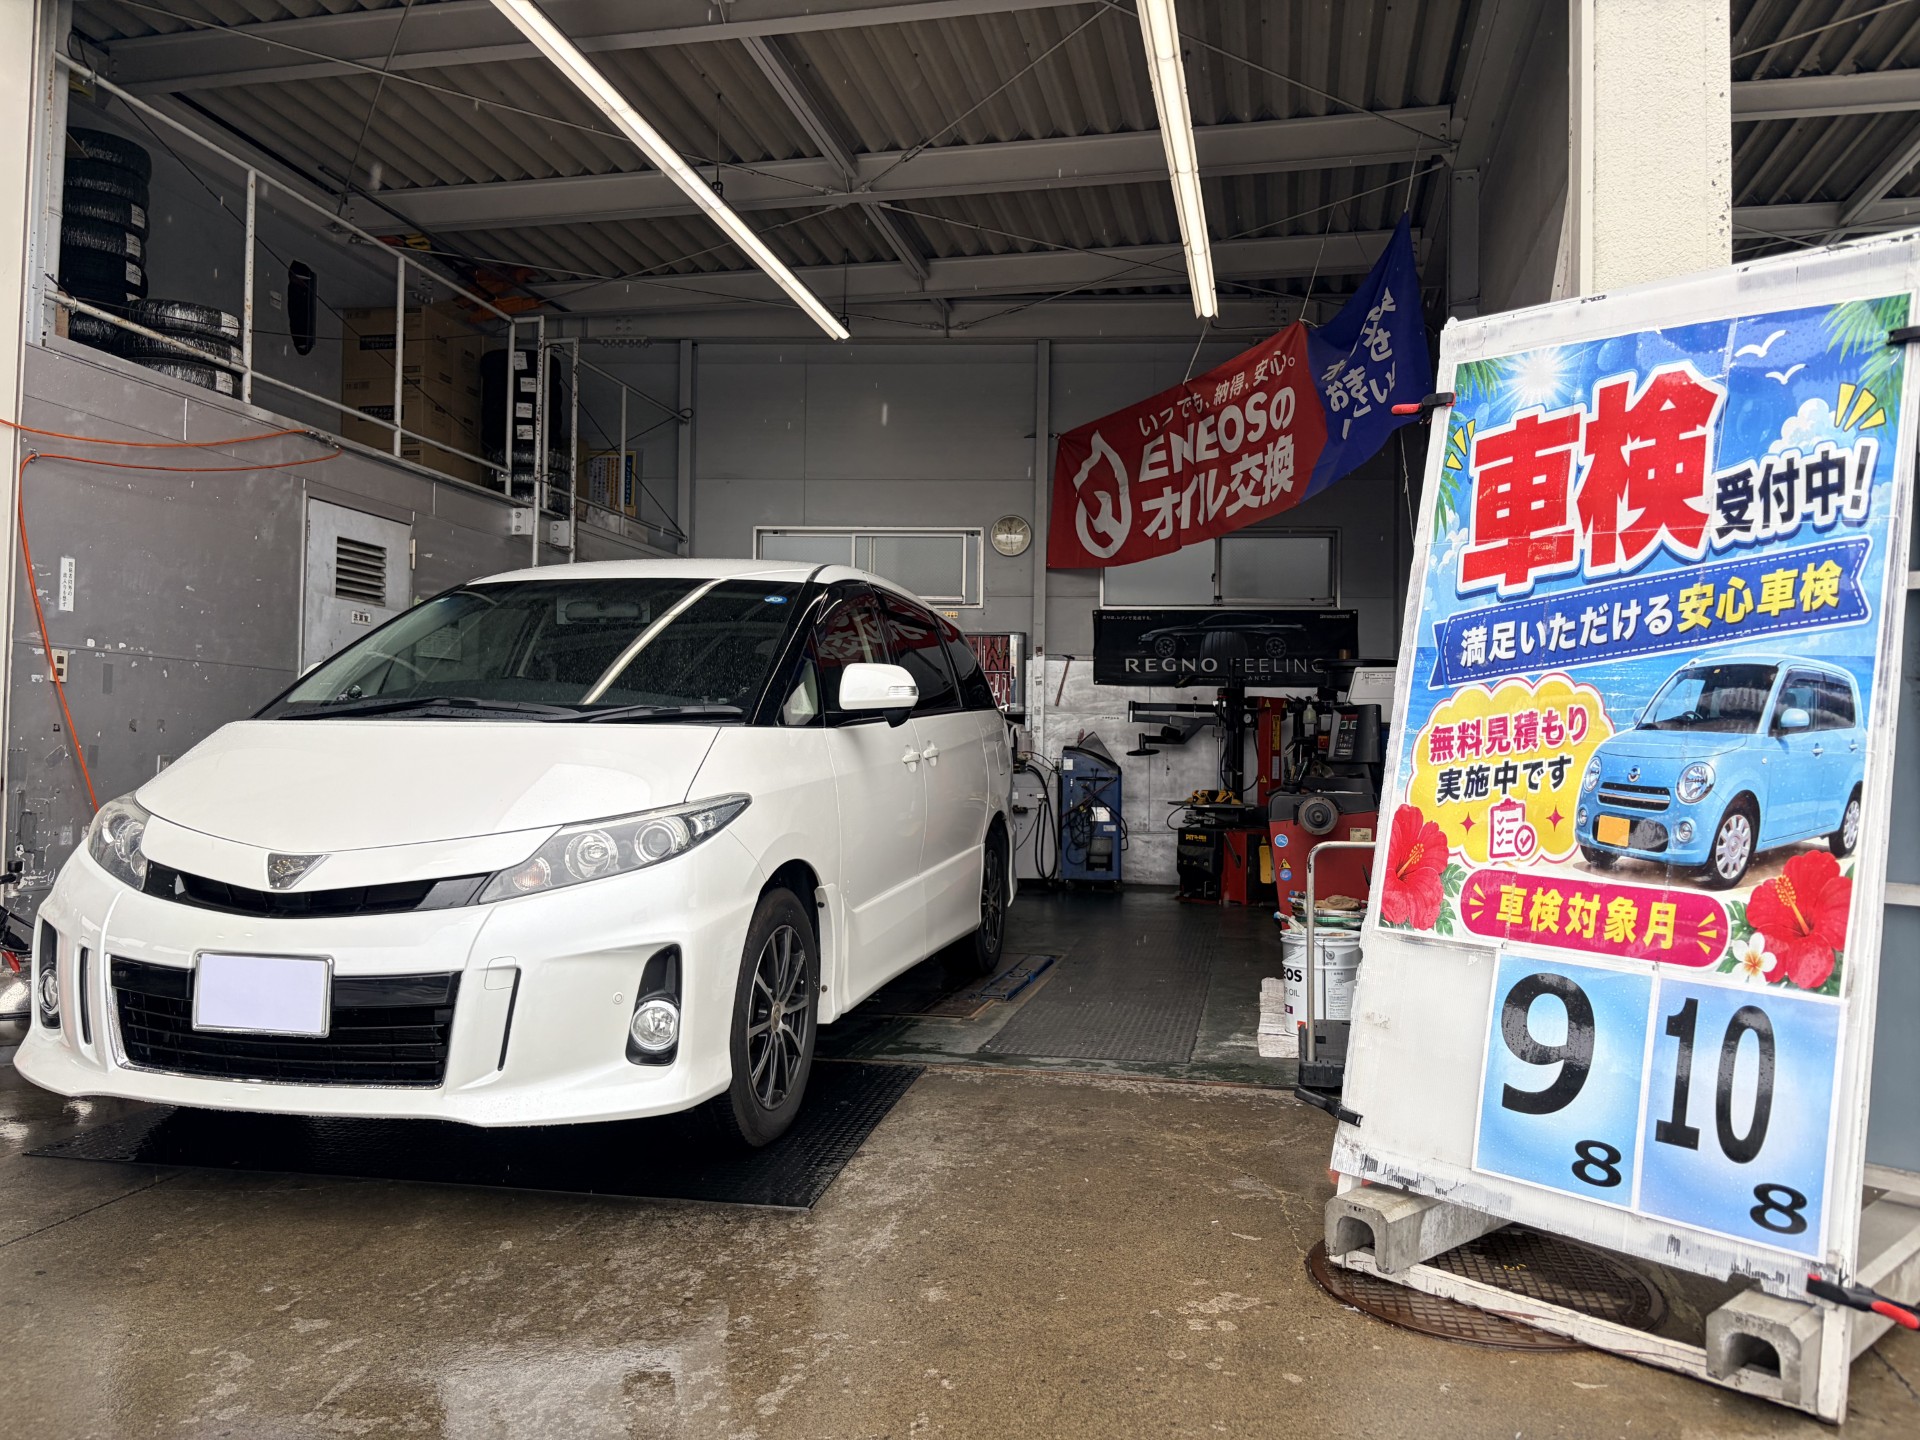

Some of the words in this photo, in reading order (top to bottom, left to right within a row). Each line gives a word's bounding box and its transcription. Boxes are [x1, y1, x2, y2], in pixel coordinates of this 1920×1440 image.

[1139, 350, 1296, 437] いつでも、納得、安心。
[1138, 385, 1296, 483] ENEOSの
[1142, 434, 1295, 541] オイル交換
[1462, 369, 1721, 588] 車検
[1125, 657, 1218, 673] REGNO
[1428, 706, 1588, 764] 無料見積もり
[1436, 753, 1574, 805] 実施中です
[1495, 882, 1679, 950] 車検対象月
[1500, 972, 1596, 1115] 9
[1654, 997, 1776, 1165] 10
[1571, 1139, 1622, 1188] 8
[1749, 1183, 1808, 1235] 8
